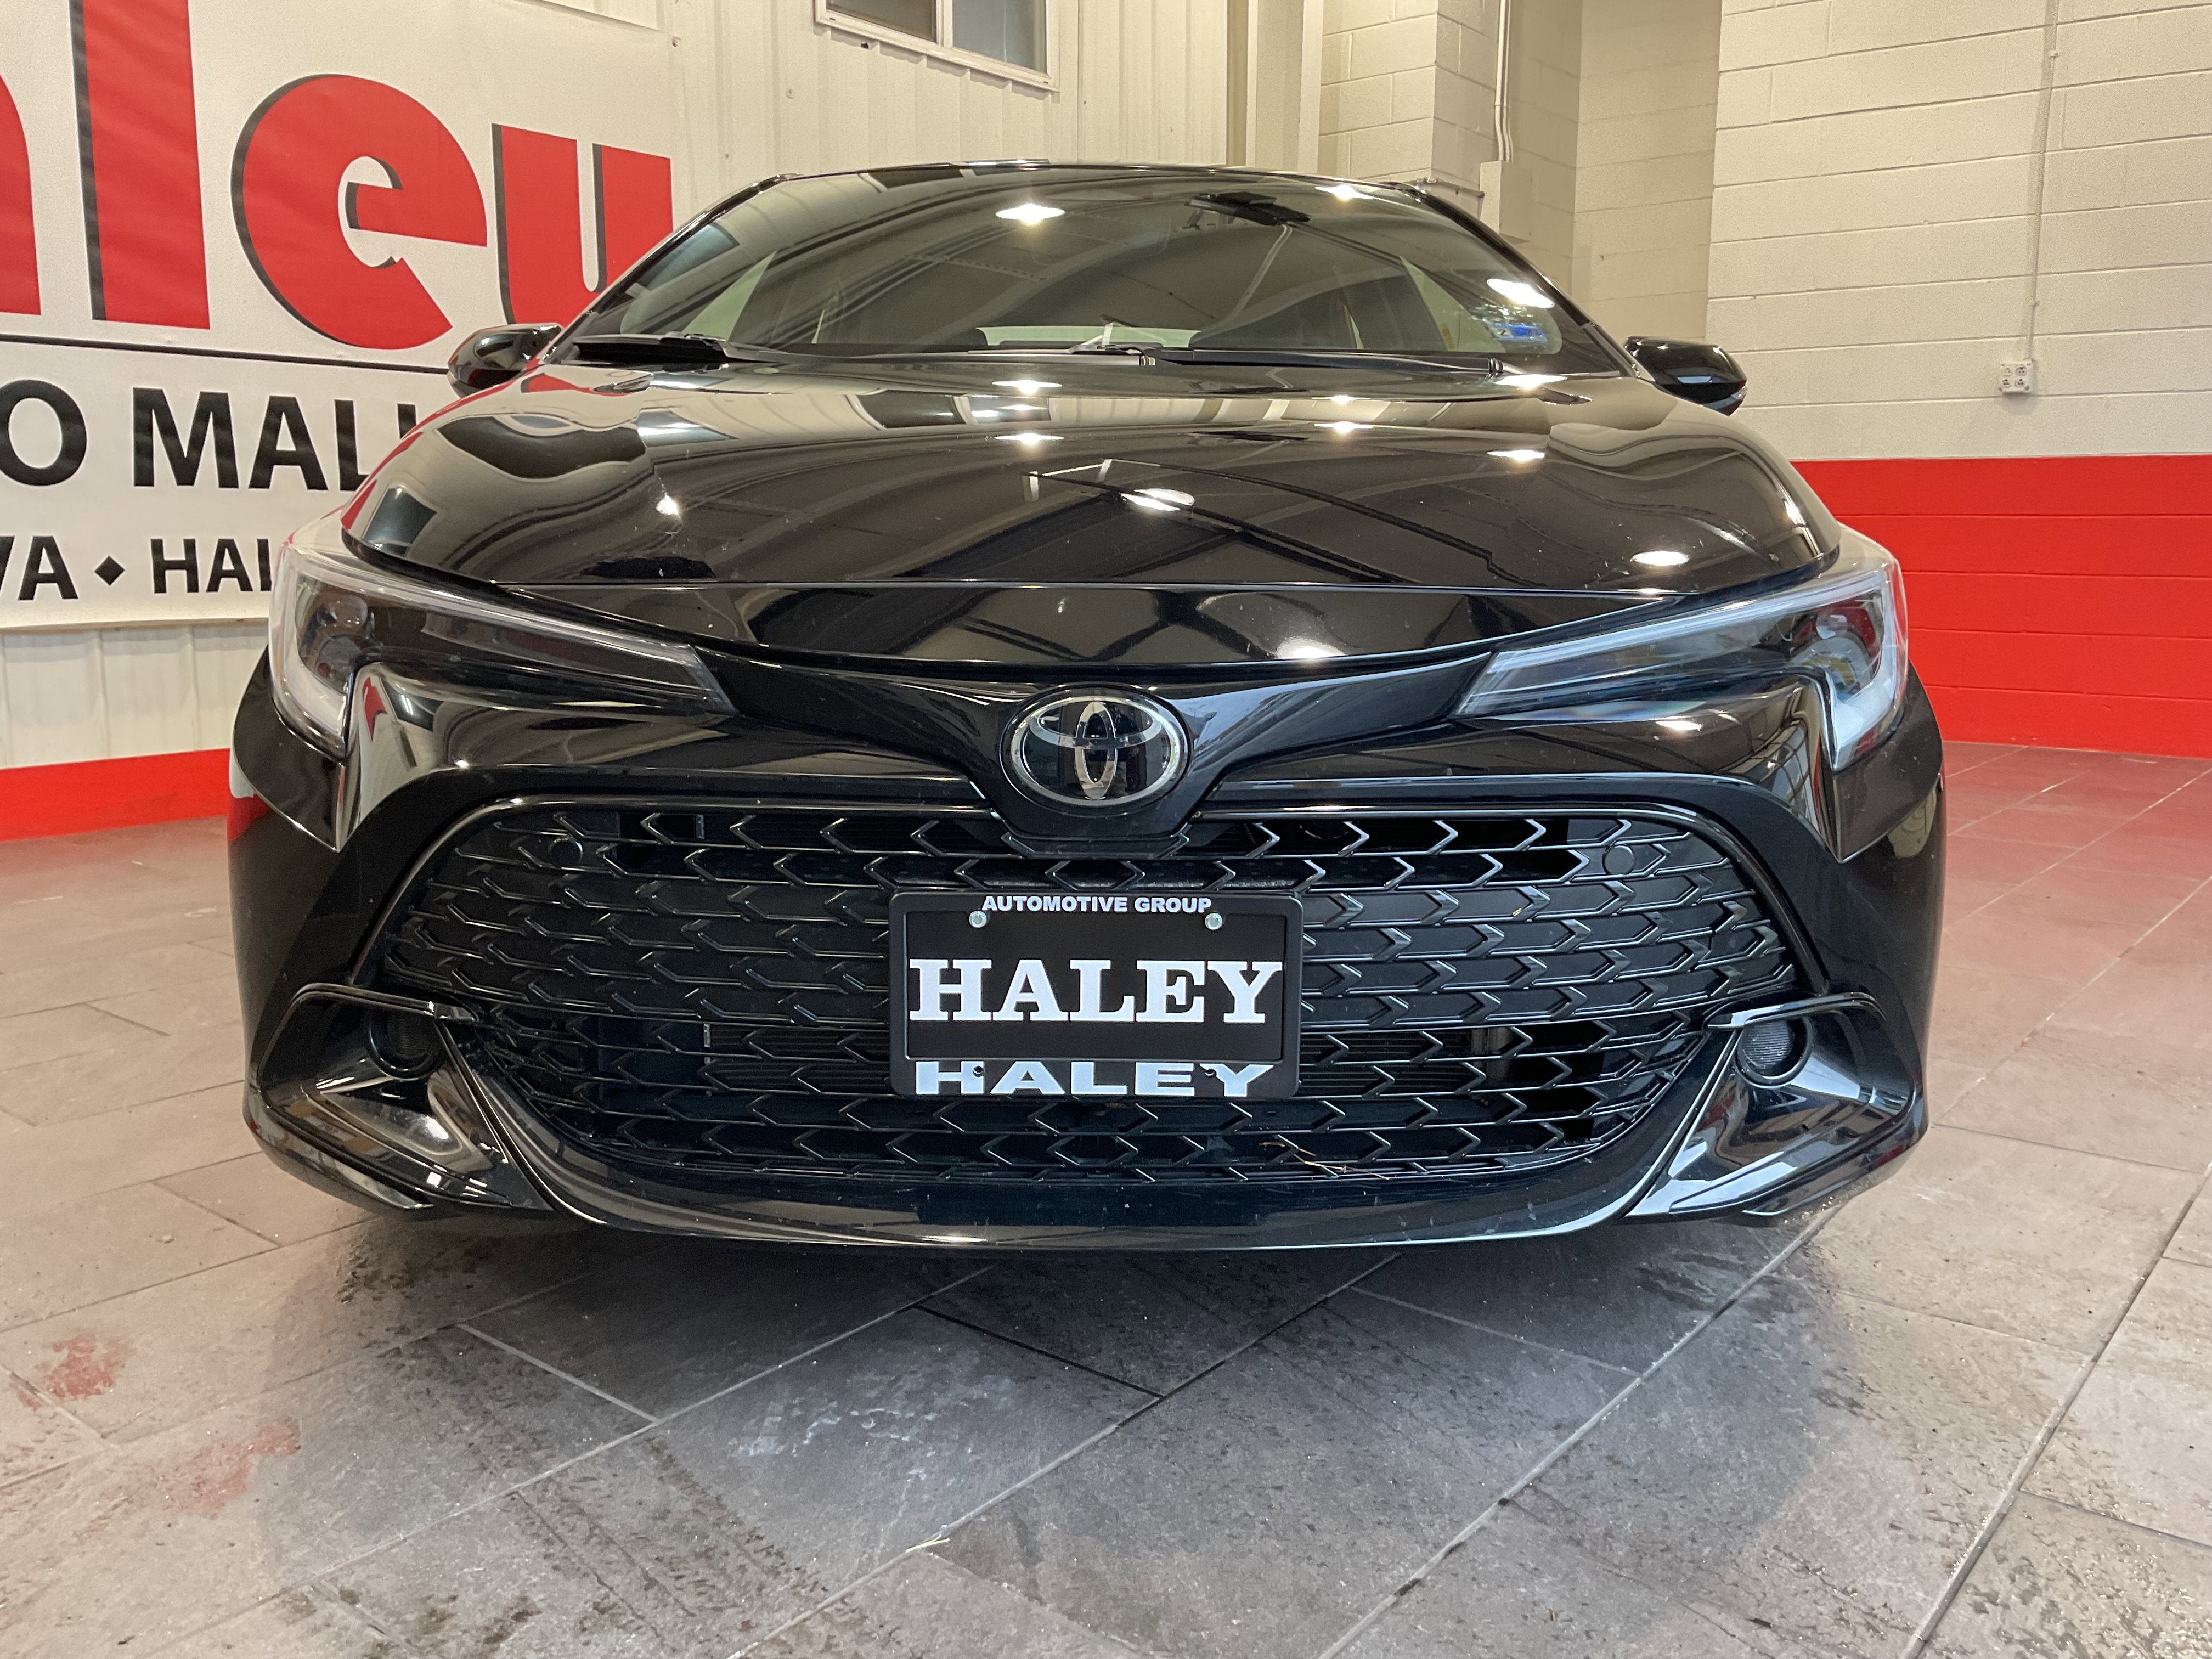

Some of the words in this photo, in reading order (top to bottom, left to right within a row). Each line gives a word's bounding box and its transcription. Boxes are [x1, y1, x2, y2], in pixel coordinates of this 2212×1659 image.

[0, 0, 673, 350] le
[982, 896, 1127, 912] AUTOMOTIVE
[1134, 897, 1211, 913] GROUP
[909, 959, 1282, 1023] HALEY
[916, 1061, 1273, 1097] HALEY
